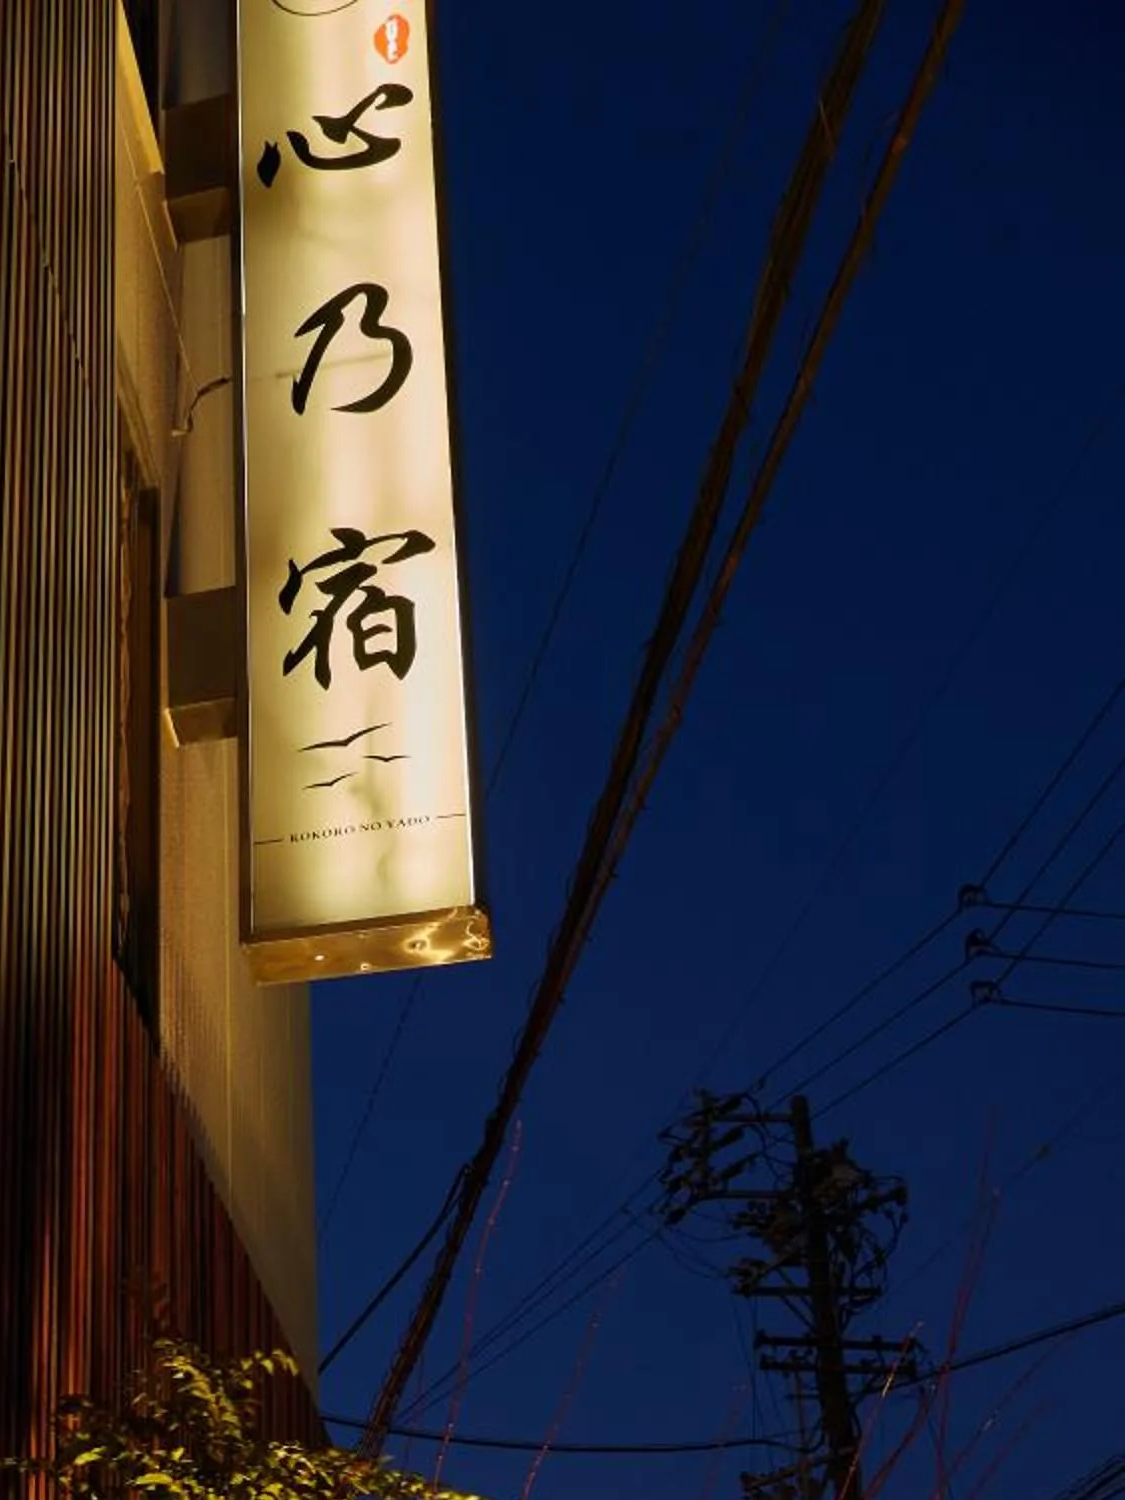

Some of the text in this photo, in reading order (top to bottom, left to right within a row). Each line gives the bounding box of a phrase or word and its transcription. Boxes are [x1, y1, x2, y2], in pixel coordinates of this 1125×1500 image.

[257, 83, 436, 691] 心乃宿
[290, 815, 430, 843] KOKORO NO YADO
